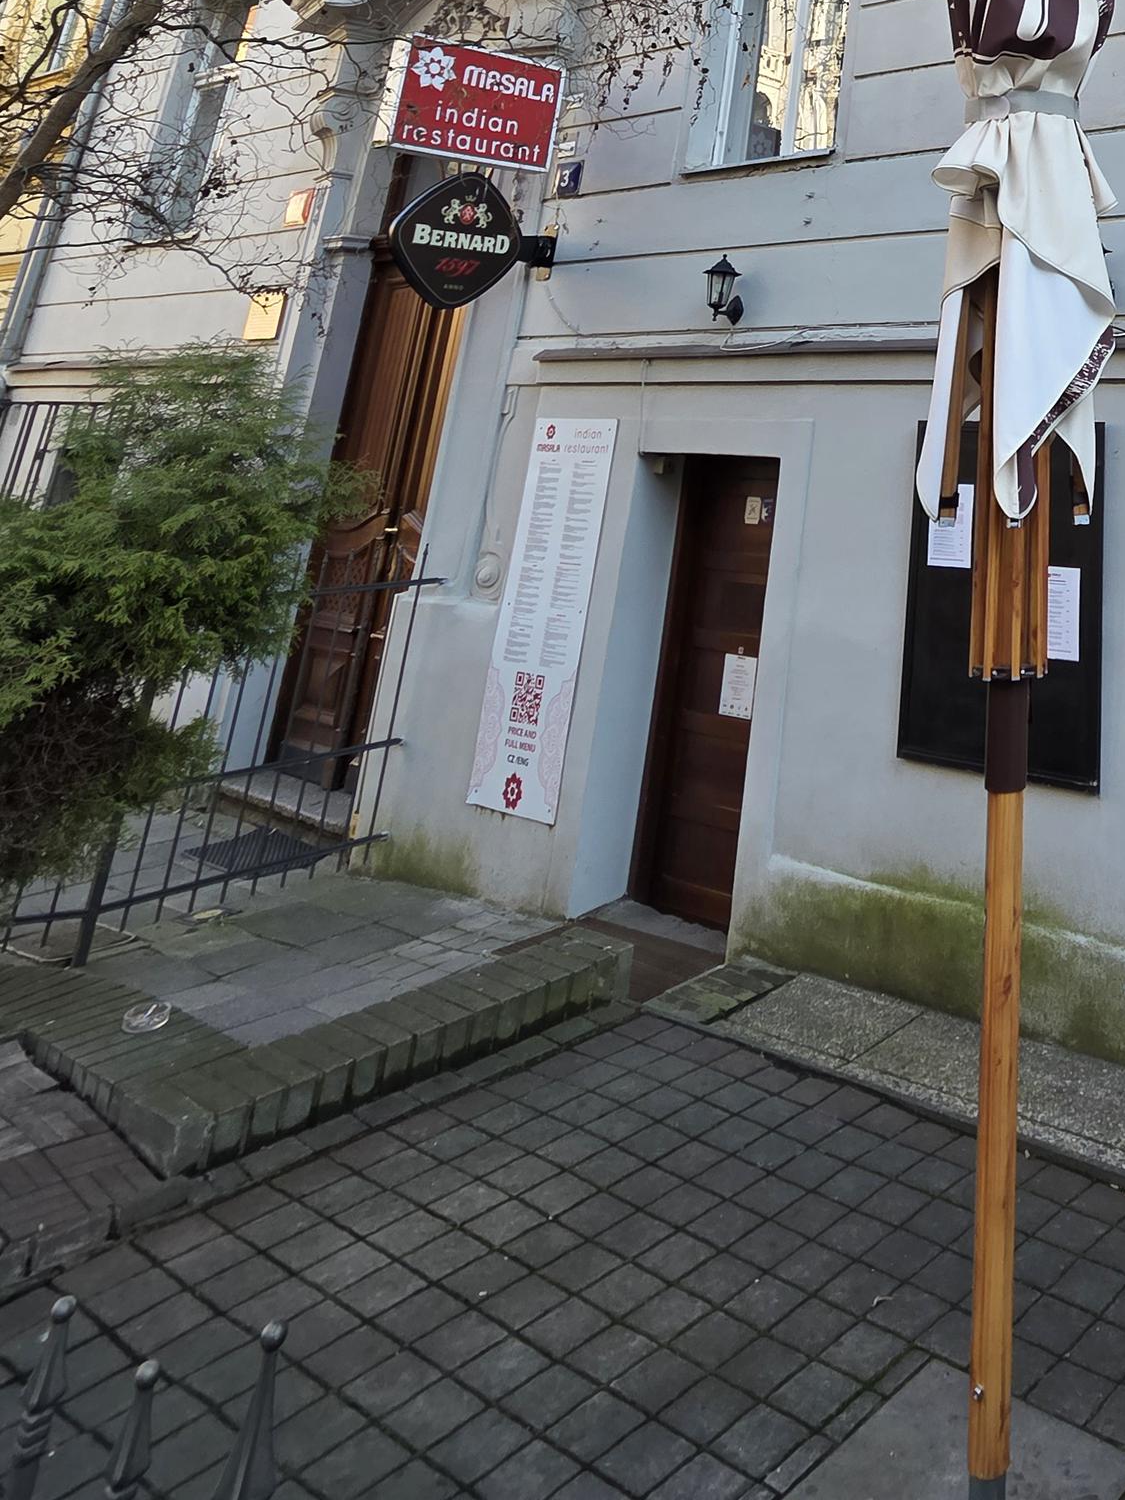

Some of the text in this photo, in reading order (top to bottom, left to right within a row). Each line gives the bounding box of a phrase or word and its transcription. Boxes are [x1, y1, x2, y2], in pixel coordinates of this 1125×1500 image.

[462, 65, 555, 103] MASALA
[435, 100, 519, 136] indian
[402, 124, 541, 162] restaurant
[412, 223, 511, 255] BERNARD
[574, 428, 603, 440] indian
[563, 443, 610, 454] restaurant
[507, 726, 537, 740] PRICE AND
[504, 738, 536, 753] FULL MENU
